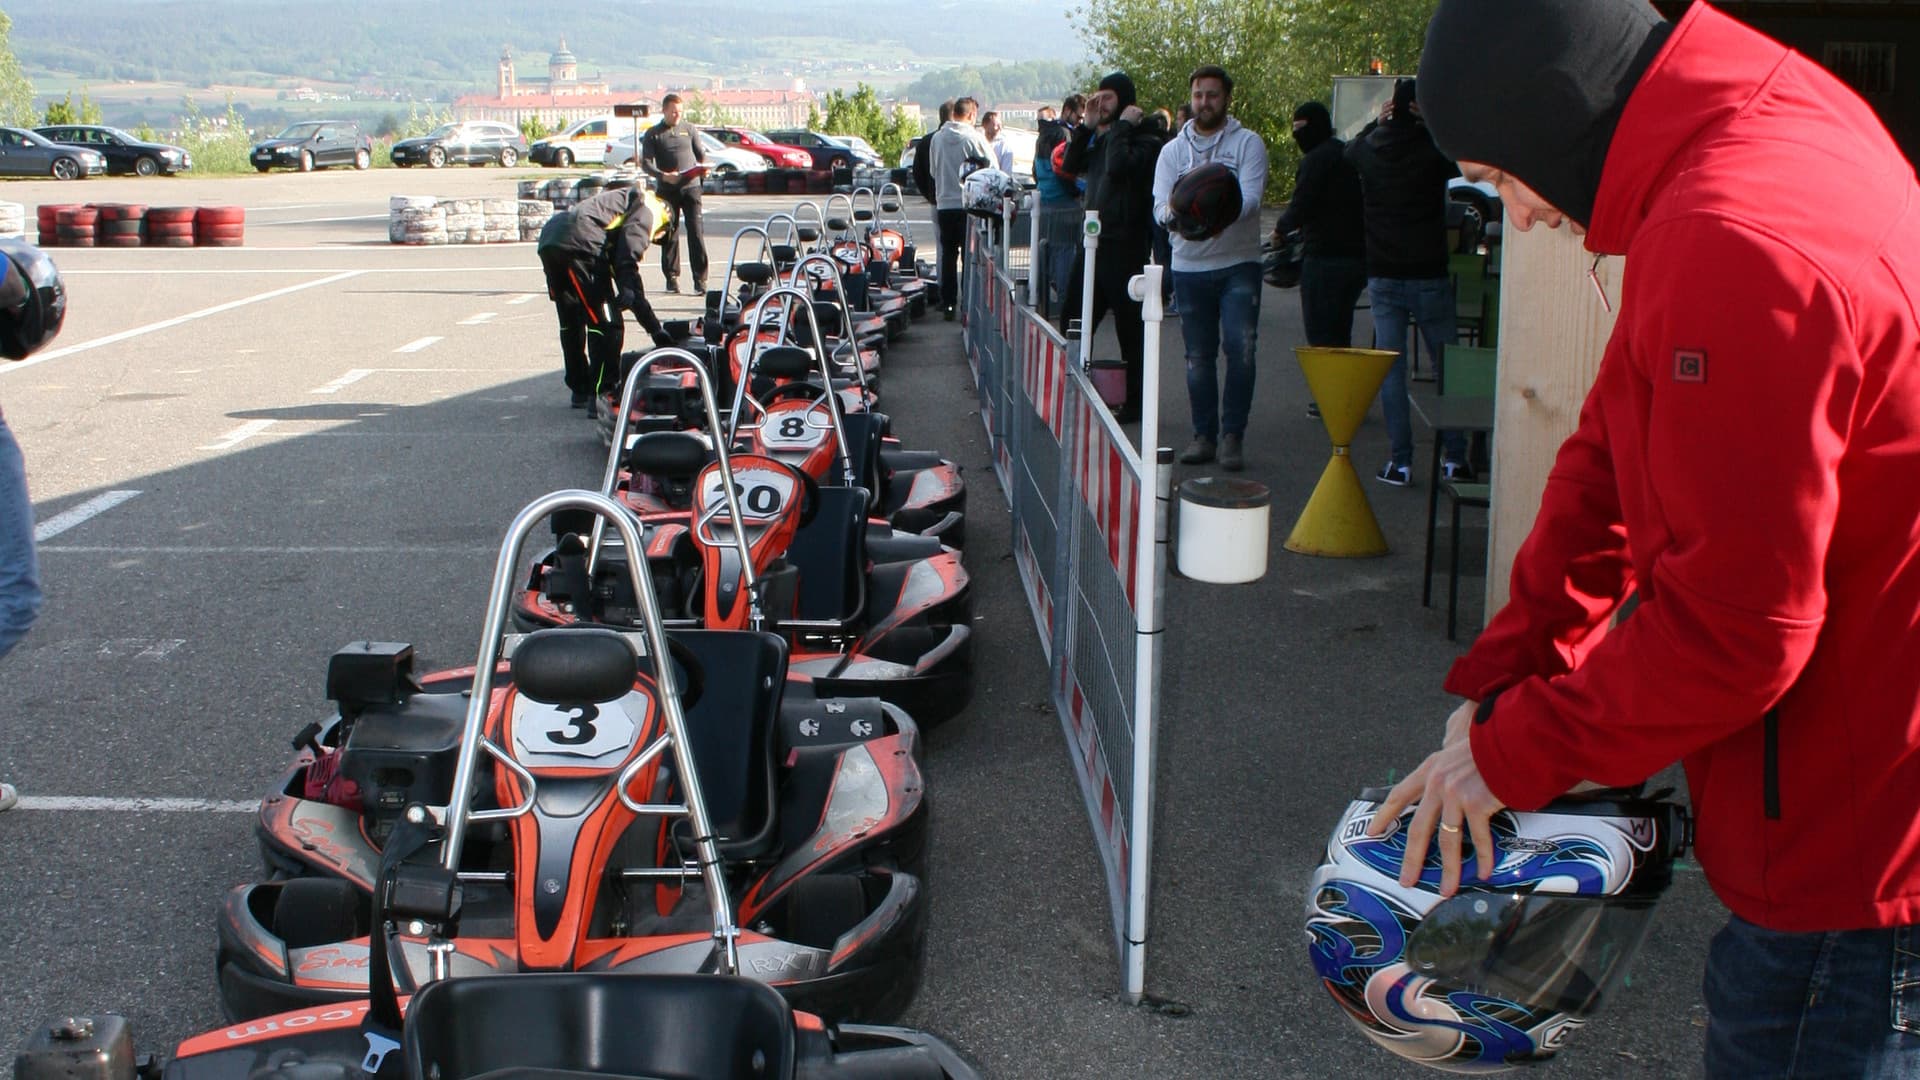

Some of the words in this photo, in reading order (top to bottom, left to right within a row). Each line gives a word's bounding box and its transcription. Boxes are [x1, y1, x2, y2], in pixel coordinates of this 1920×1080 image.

[814, 266, 825, 275] 5
[779, 417, 804, 437] 8
[545, 702, 600, 745] 3
